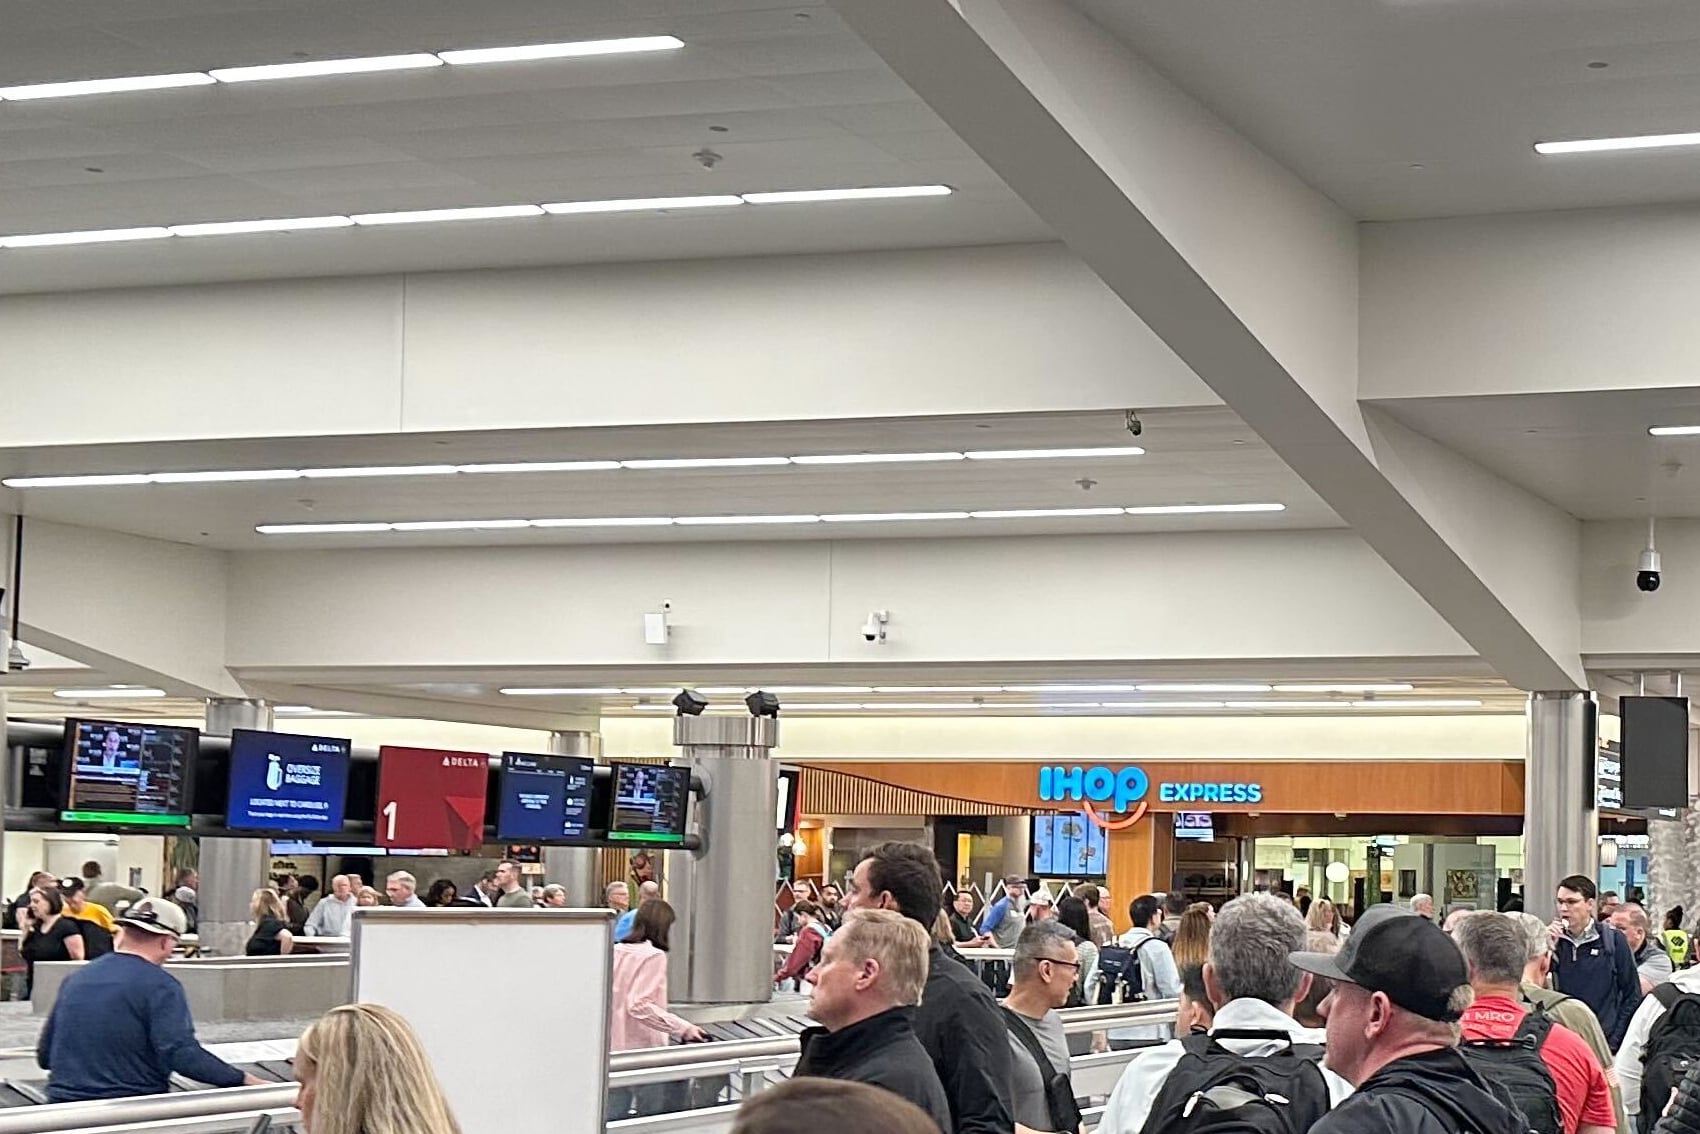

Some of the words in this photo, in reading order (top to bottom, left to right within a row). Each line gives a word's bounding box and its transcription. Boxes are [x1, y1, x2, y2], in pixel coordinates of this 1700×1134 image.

[451, 757, 479, 767] DELTA
[286, 763, 321, 775] OVERSIZE
[285, 773, 321, 785] BAGGAGE
[1039, 766, 1149, 814] IHOP
[1159, 783, 1263, 803] EXPRESS
[383, 801, 398, 841] 1
[1475, 1010, 1516, 1022] MRO
